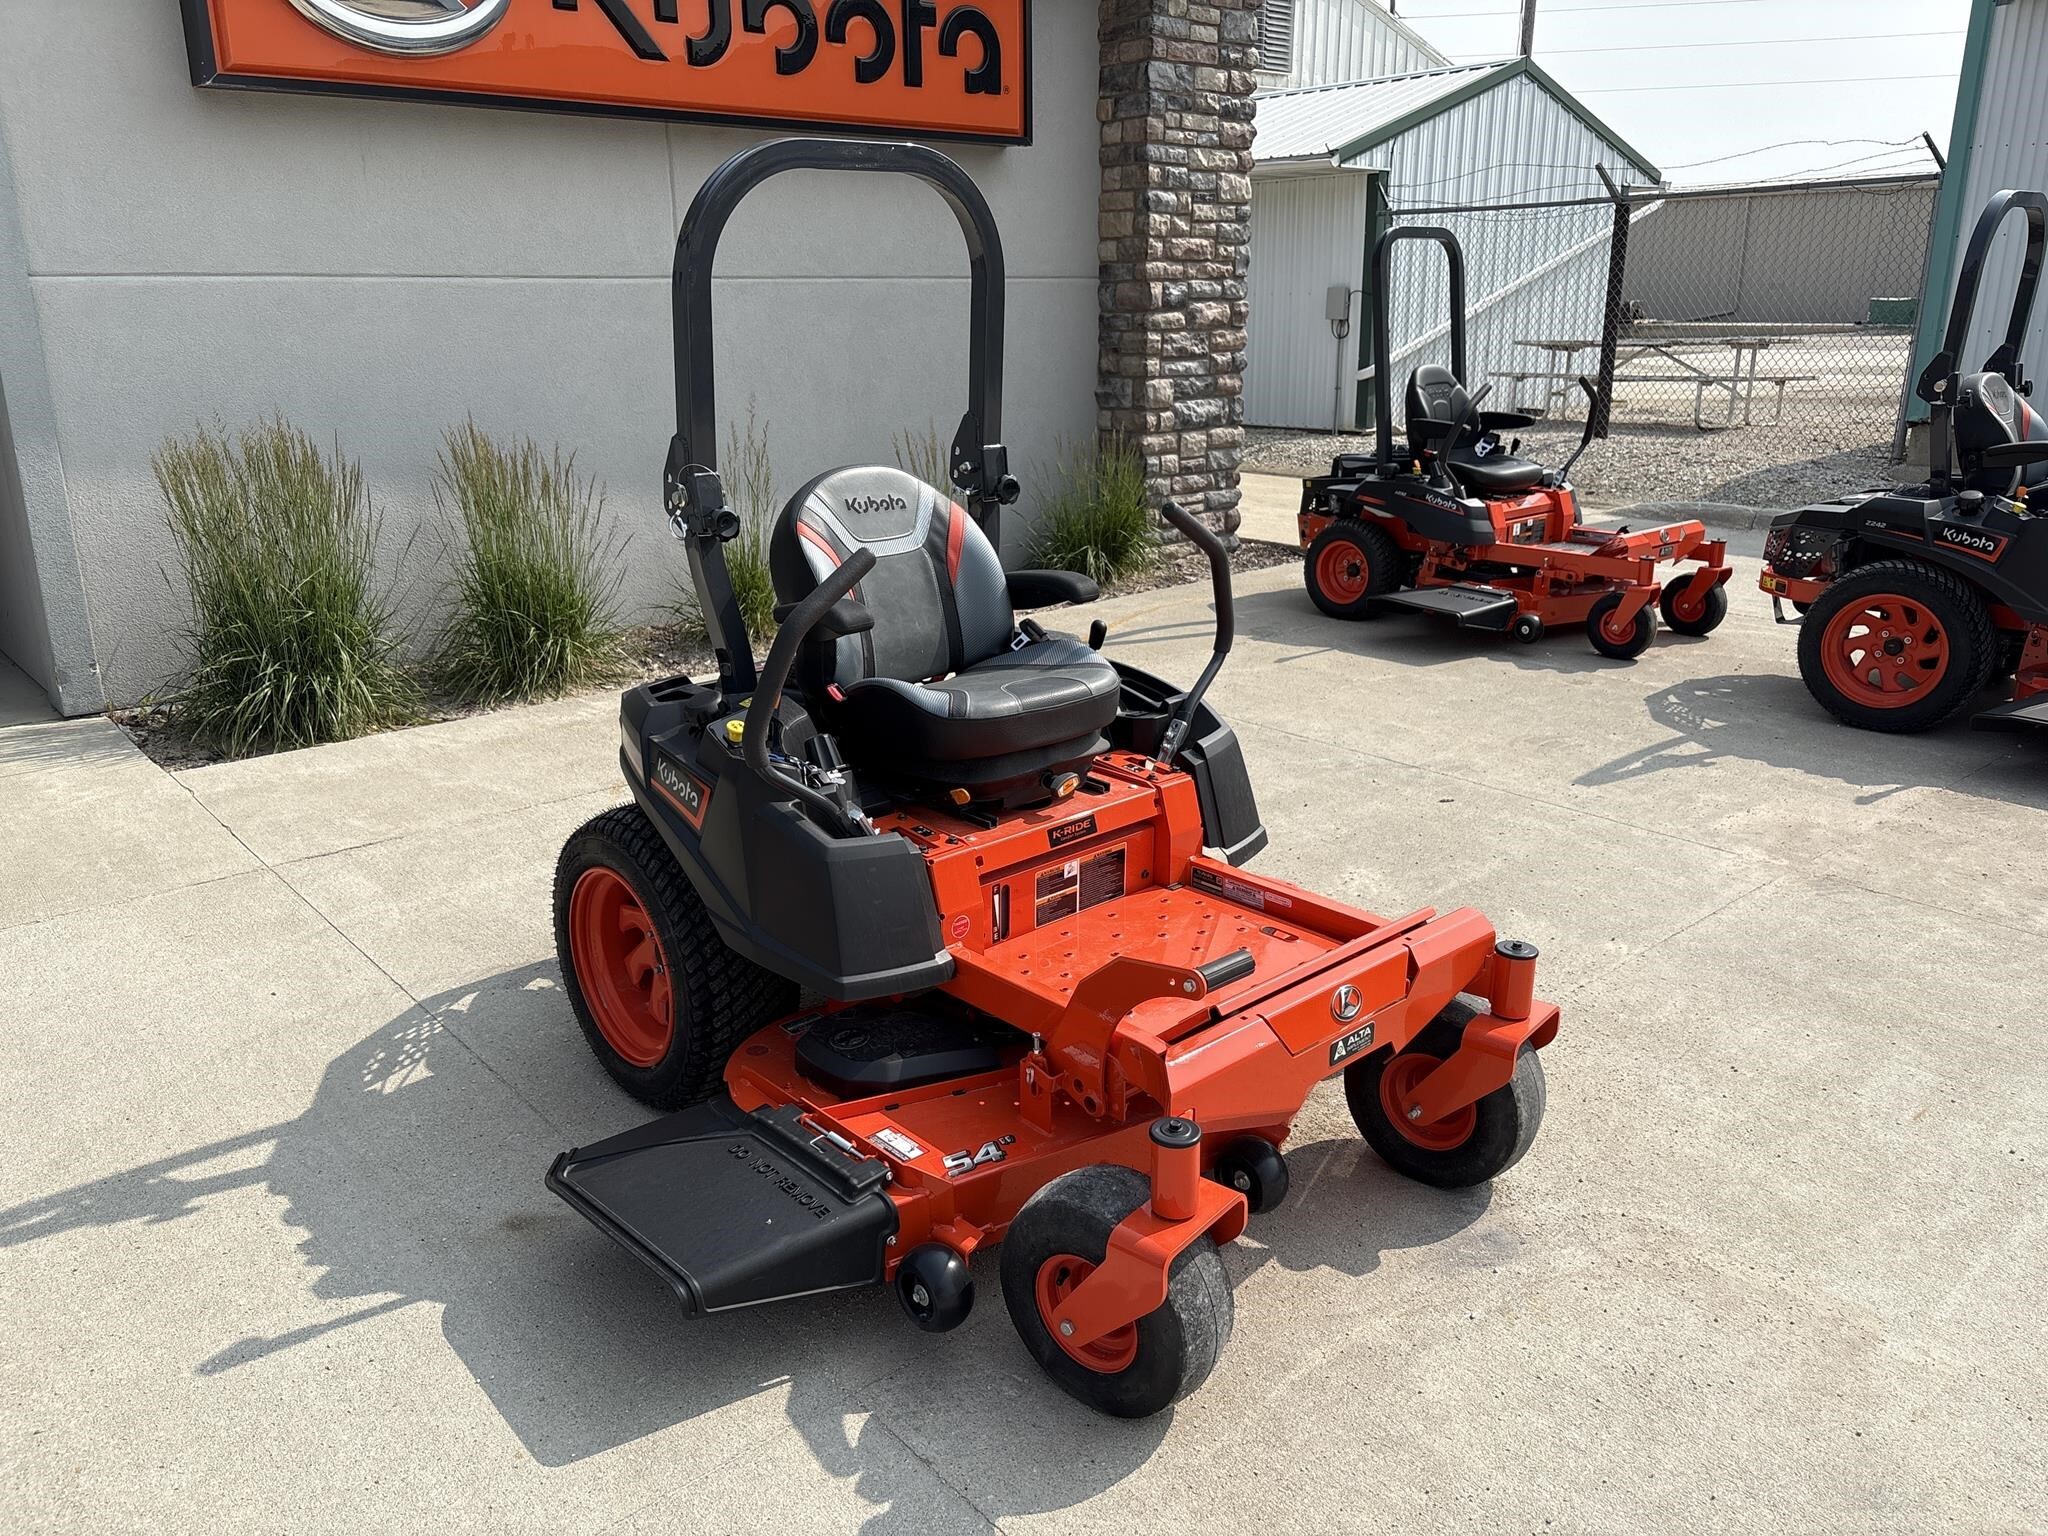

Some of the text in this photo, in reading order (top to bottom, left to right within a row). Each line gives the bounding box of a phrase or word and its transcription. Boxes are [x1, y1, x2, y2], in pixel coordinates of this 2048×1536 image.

[844, 494, 906, 514] Kubota
[1425, 494, 1457, 510] Kubota
[1943, 527, 1995, 551] Kubota
[657, 757, 698, 808] Kubota
[1053, 819, 1091, 839] K-RIDE
[1347, 1026, 1371, 1046] ALTA
[728, 1144, 832, 1219] DO NOT REMOVE
